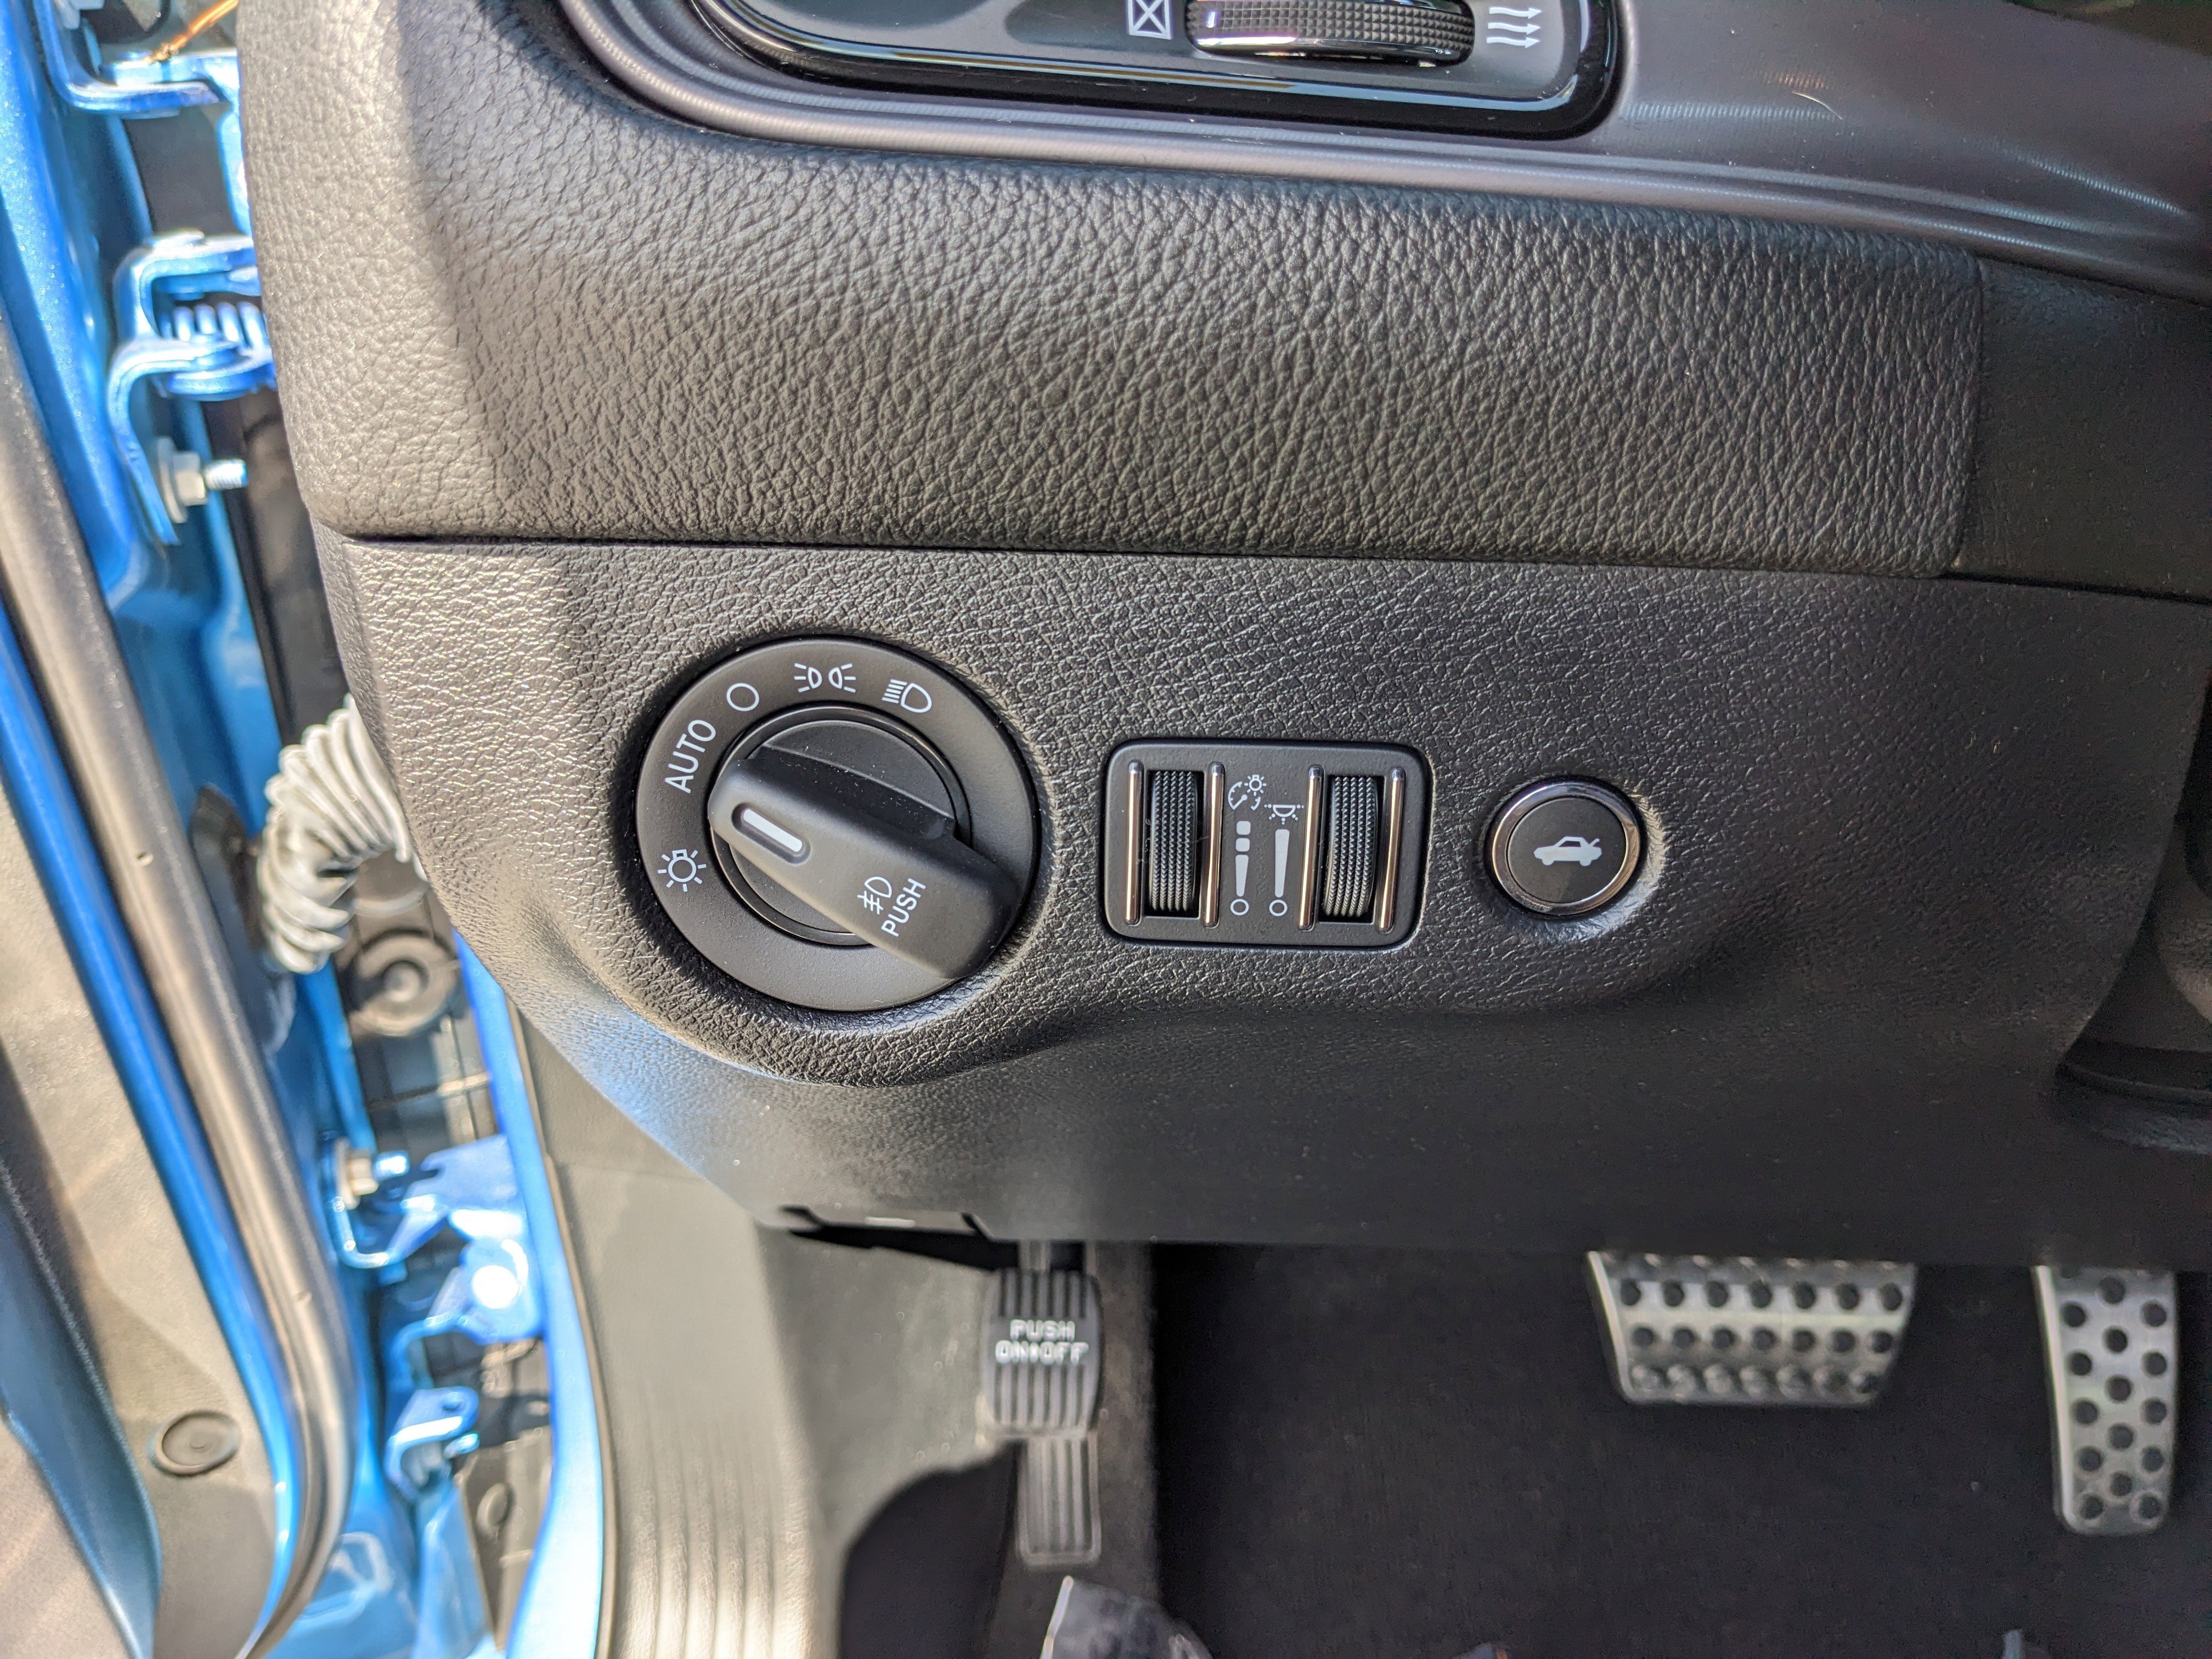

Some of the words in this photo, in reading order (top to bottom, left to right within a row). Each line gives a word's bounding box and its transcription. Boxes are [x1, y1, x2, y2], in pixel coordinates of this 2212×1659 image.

[664, 719, 716, 793] AUTO
[881, 878, 926, 936] PUSH
[1010, 1319, 1075, 1341] PUSH
